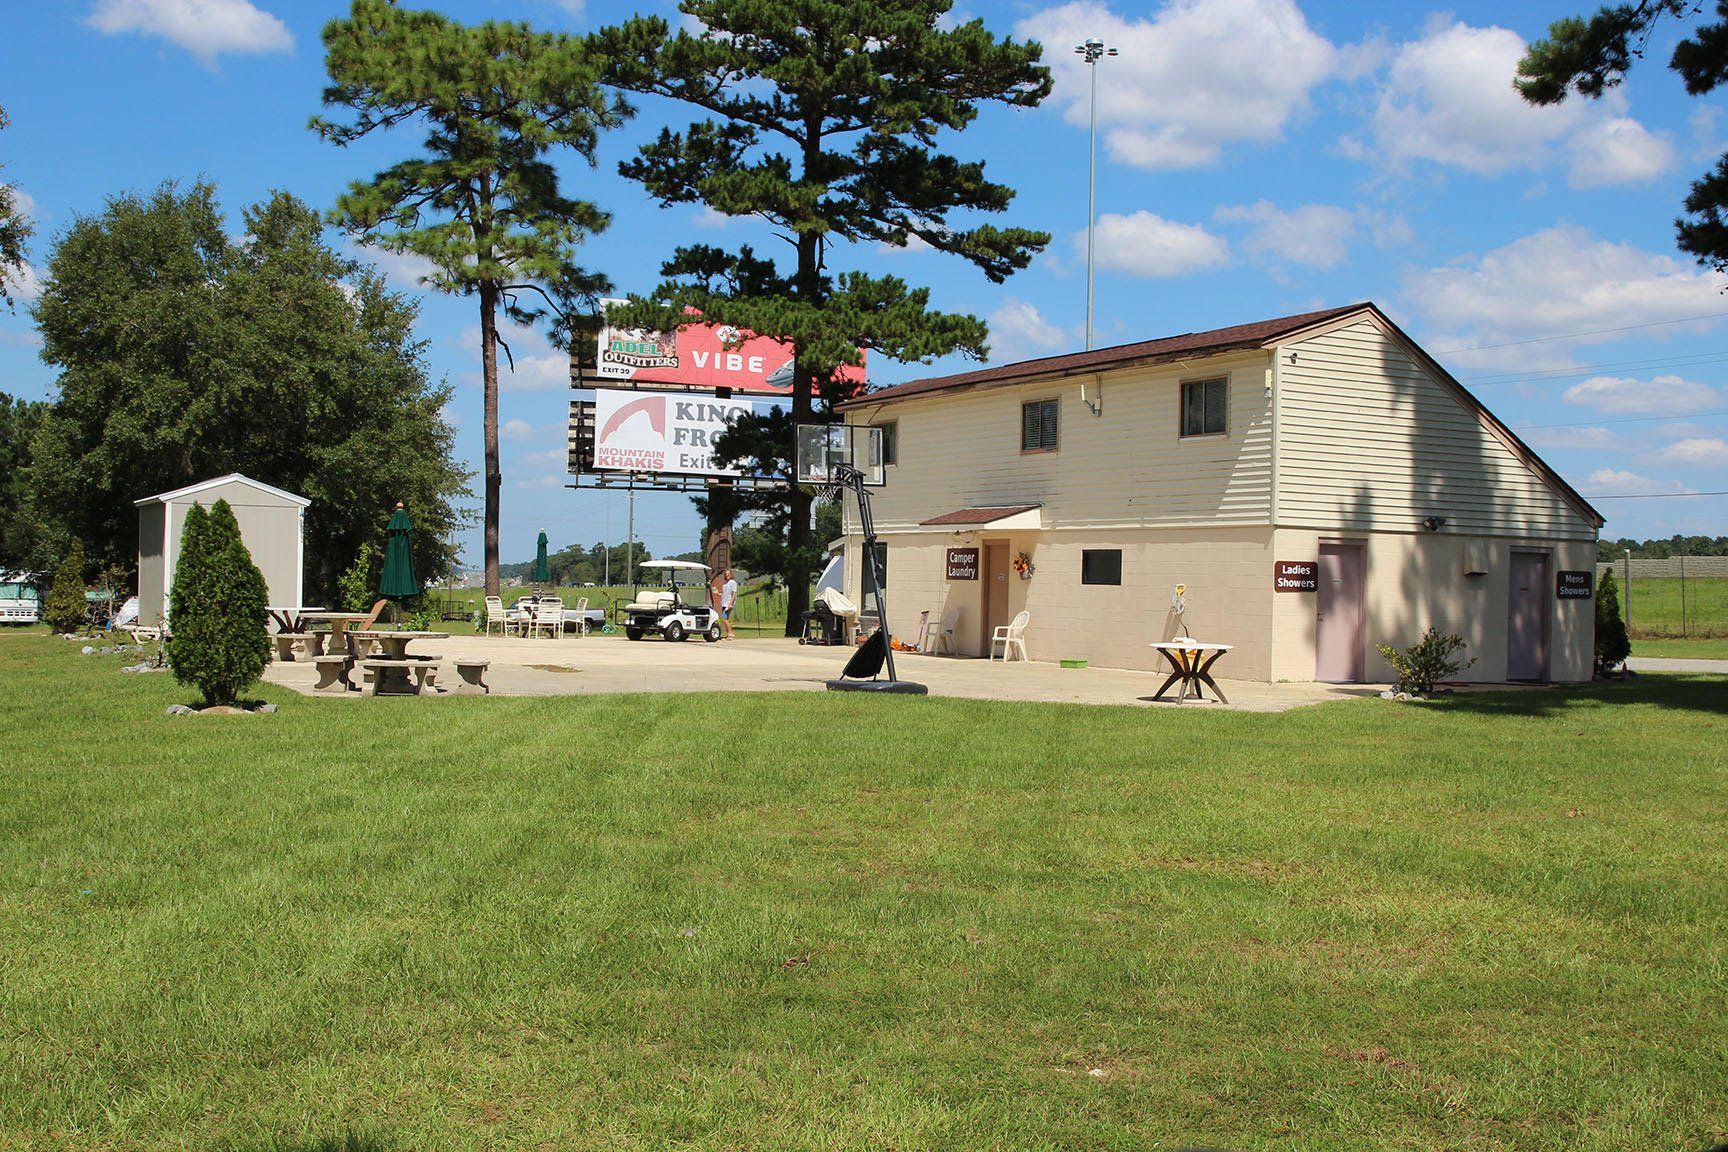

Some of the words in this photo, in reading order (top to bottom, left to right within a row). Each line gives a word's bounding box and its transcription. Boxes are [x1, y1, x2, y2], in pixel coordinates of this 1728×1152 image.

[611, 340, 662, 356] ADEL
[604, 352, 678, 368] OUTFITTERS
[692, 351, 763, 373] VIBE
[602, 366, 620, 374] EXIT
[598, 447, 665, 459] MOUNTAIN
[598, 456, 665, 470] KHAKIS
[680, 453, 713, 470] Exit
[950, 552, 975, 566] Camper
[948, 566, 976, 580] Laundry
[1282, 565, 1311, 575] Ladies
[1277, 577, 1315, 588] Showers
[1565, 575, 1584, 584] Mens
[1559, 586, 1590, 596] Showers
